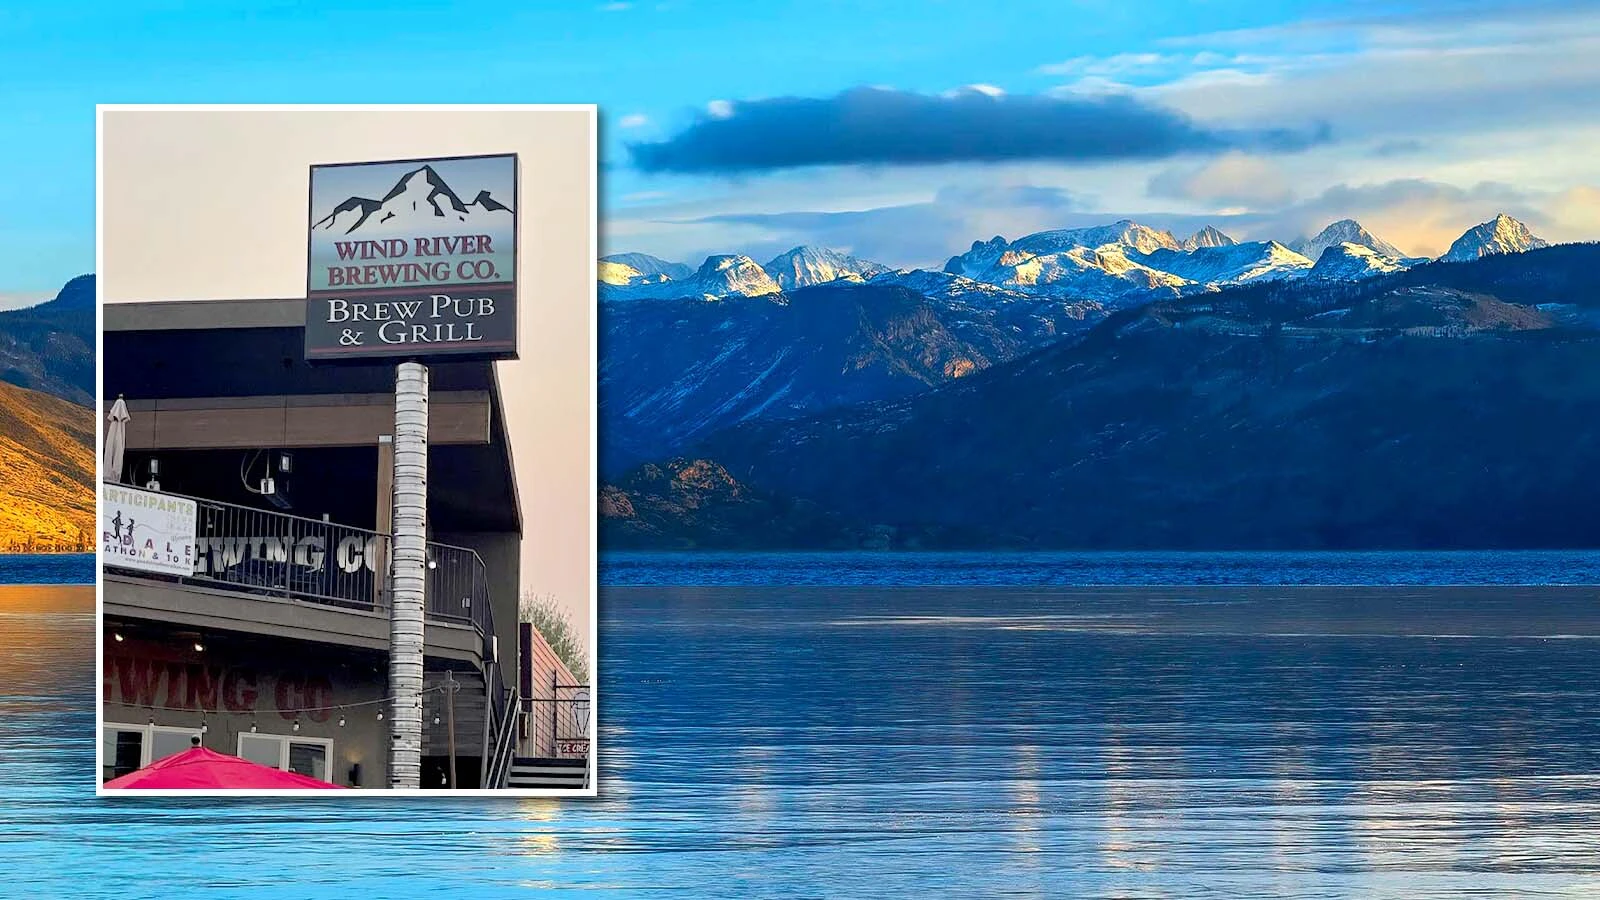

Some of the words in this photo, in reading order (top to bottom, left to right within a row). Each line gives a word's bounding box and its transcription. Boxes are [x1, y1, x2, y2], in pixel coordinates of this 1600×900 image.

[334, 238, 409, 261] WIND
[414, 235, 495, 258] RIVER
[327, 262, 450, 287] BREWING
[456, 260, 501, 280] CO.
[326, 299, 424, 323] BREW
[429, 294, 496, 319] PUB
[338, 328, 365, 346] &
[378, 320, 483, 344] GRILL
[152, 552, 159, 560] &
